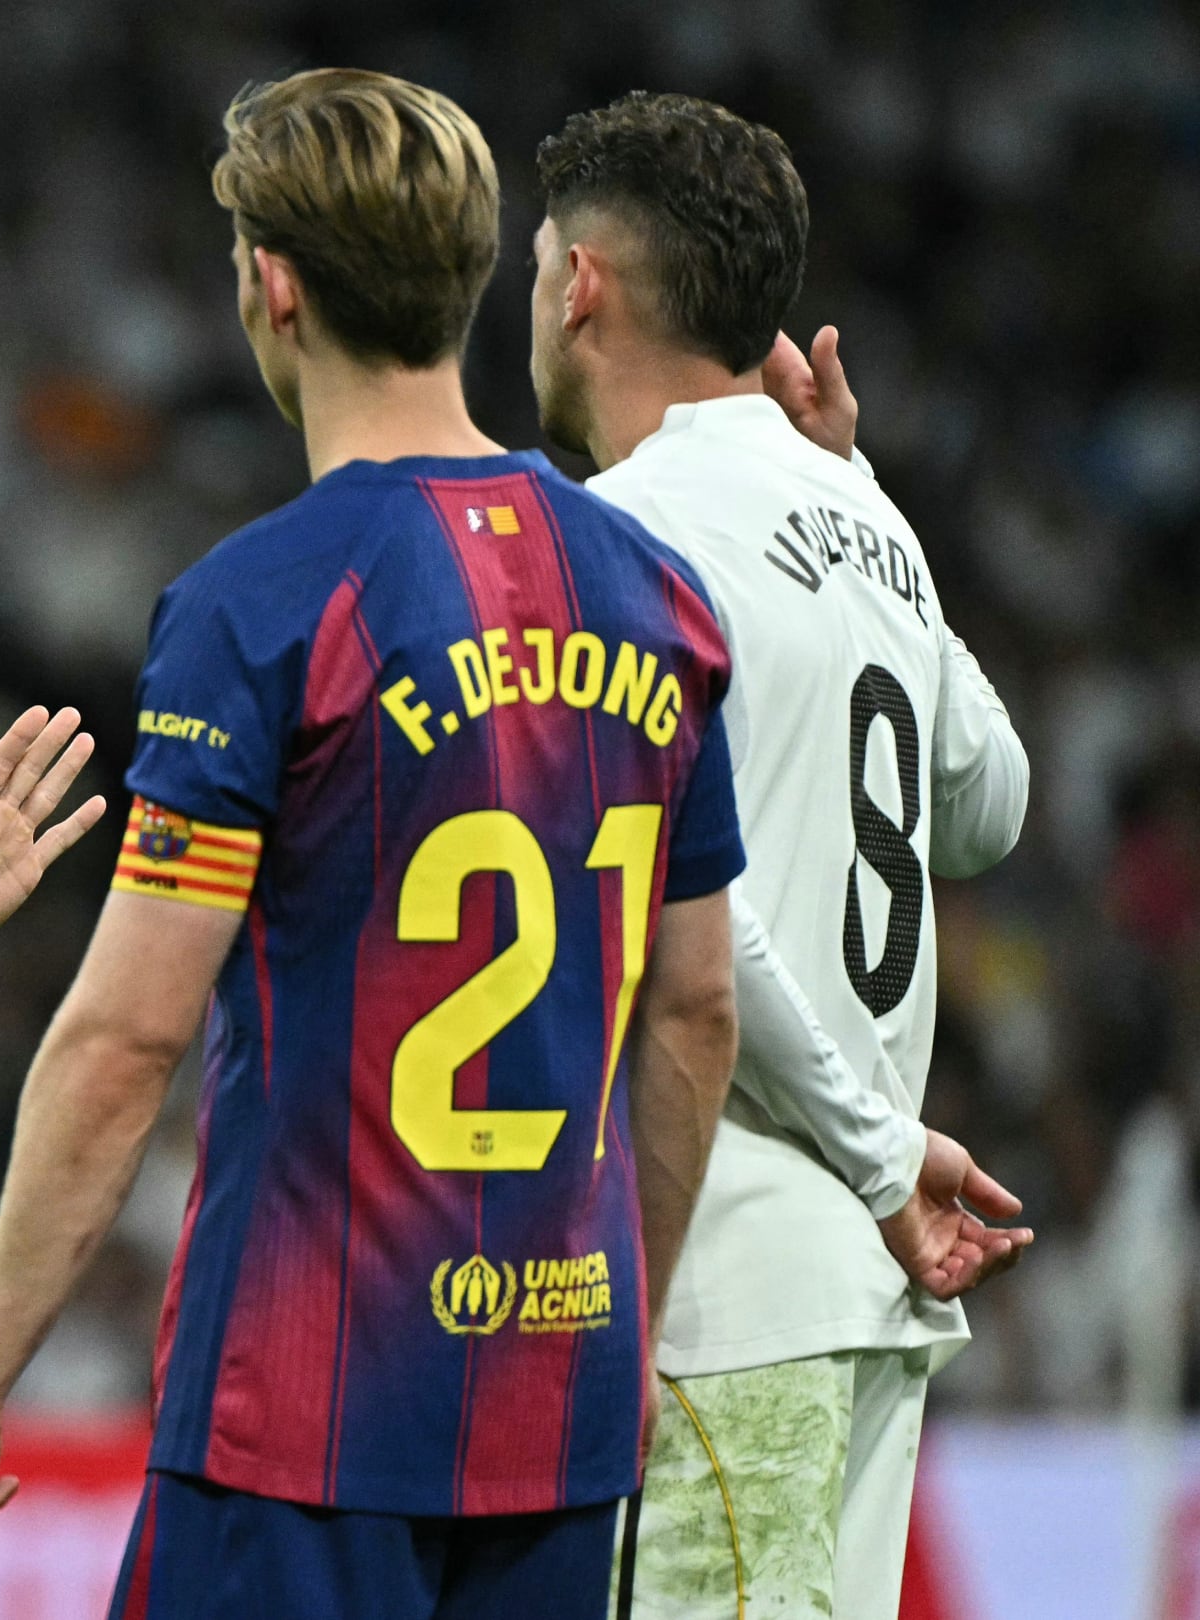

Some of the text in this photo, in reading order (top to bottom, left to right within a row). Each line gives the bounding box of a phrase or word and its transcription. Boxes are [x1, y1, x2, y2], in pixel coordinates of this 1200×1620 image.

[380, 675, 461, 756] F.
[843, 663, 923, 1019] 8
[390, 803, 664, 1171] 21
[518, 1282, 612, 1321] ACNUR
[523, 1250, 610, 1290] UNHCR
